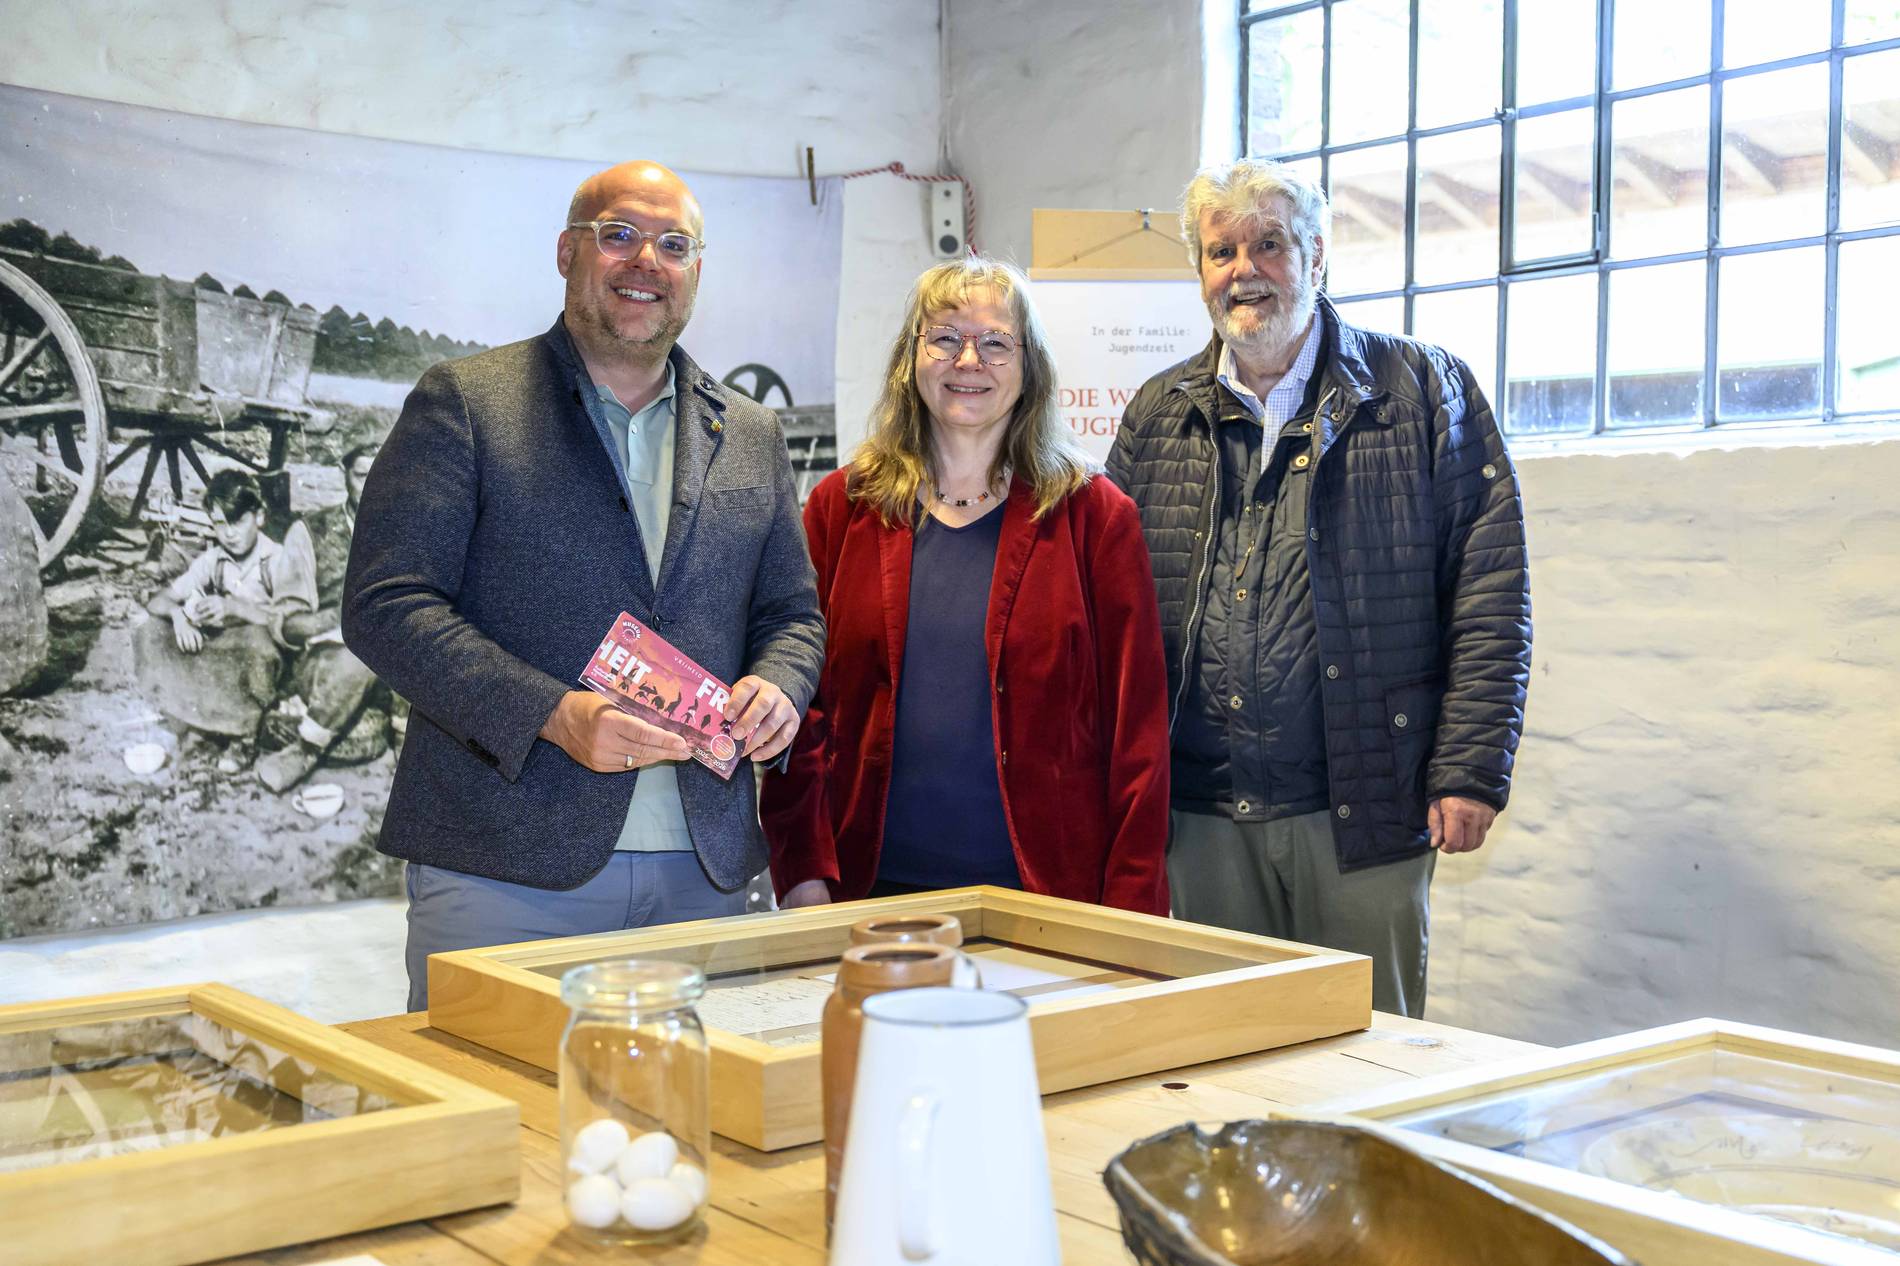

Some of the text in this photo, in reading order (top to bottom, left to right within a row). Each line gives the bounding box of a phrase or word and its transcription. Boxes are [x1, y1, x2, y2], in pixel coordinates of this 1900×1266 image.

[1091, 326, 1191, 337] In der Familie:
[1108, 343, 1176, 355] Jugendzeit
[1057, 388, 1138, 408] DIE W
[1066, 416, 1120, 436] UGE
[696, 677, 731, 714] FR
